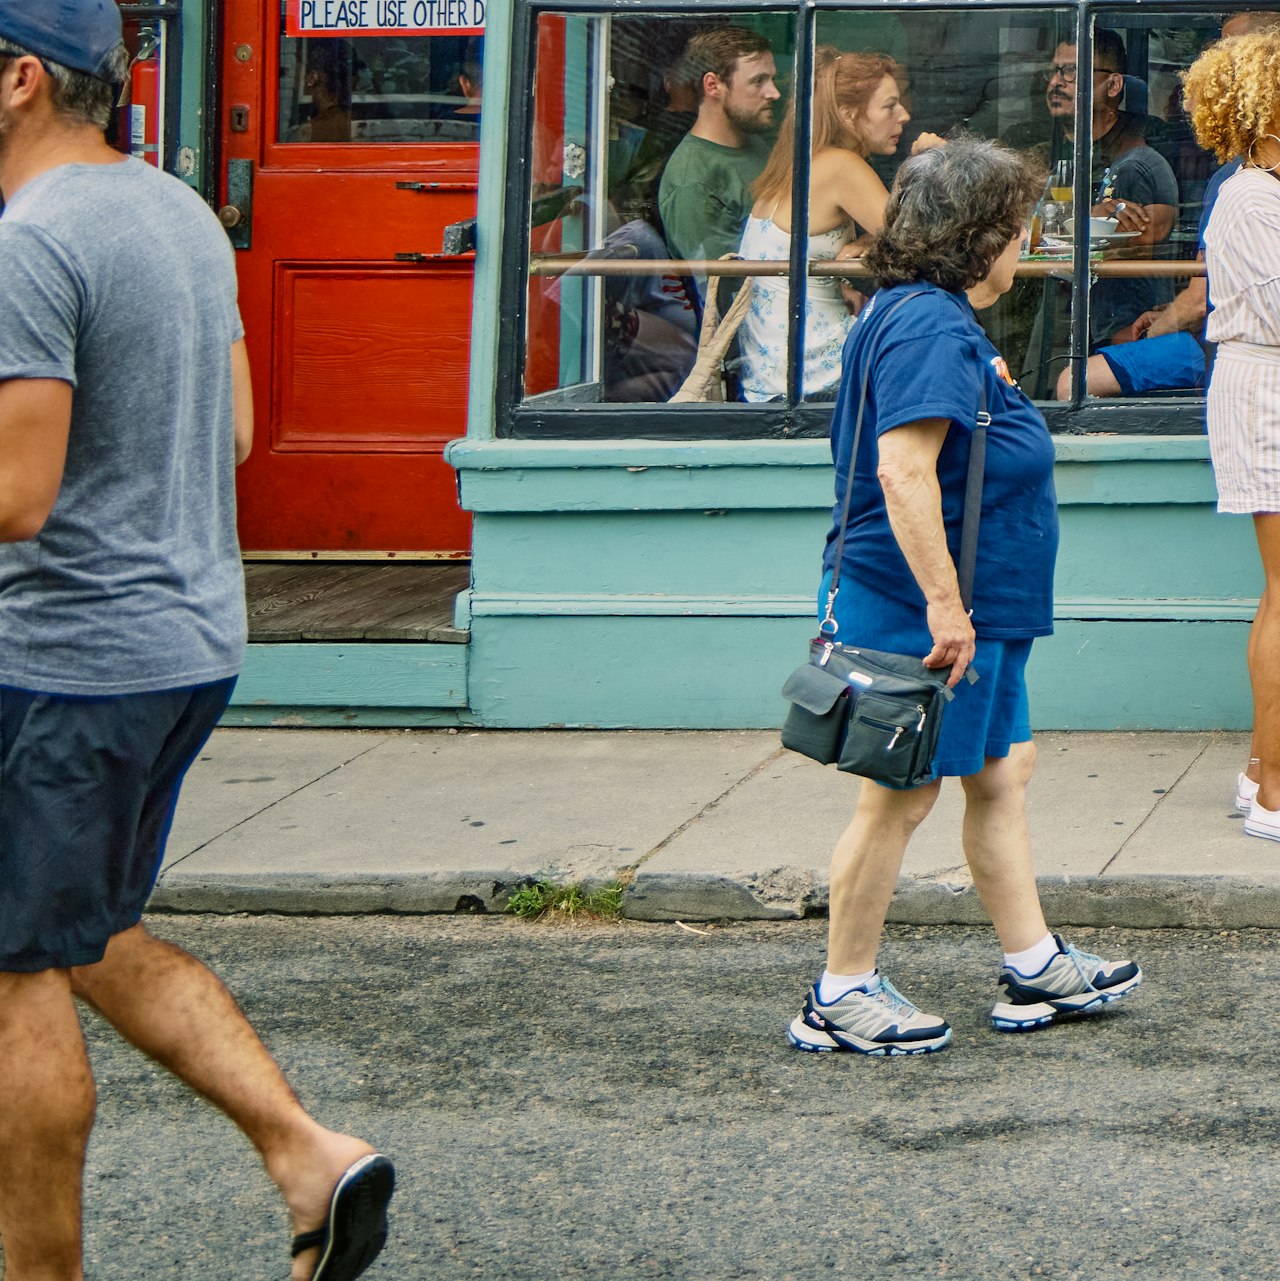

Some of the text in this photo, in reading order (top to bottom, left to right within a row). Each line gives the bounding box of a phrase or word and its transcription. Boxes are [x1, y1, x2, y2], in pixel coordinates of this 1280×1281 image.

[300, 0, 369, 29] PLEASE
[377, 0, 407, 28] USE
[413, 0, 468, 27] OTHER
